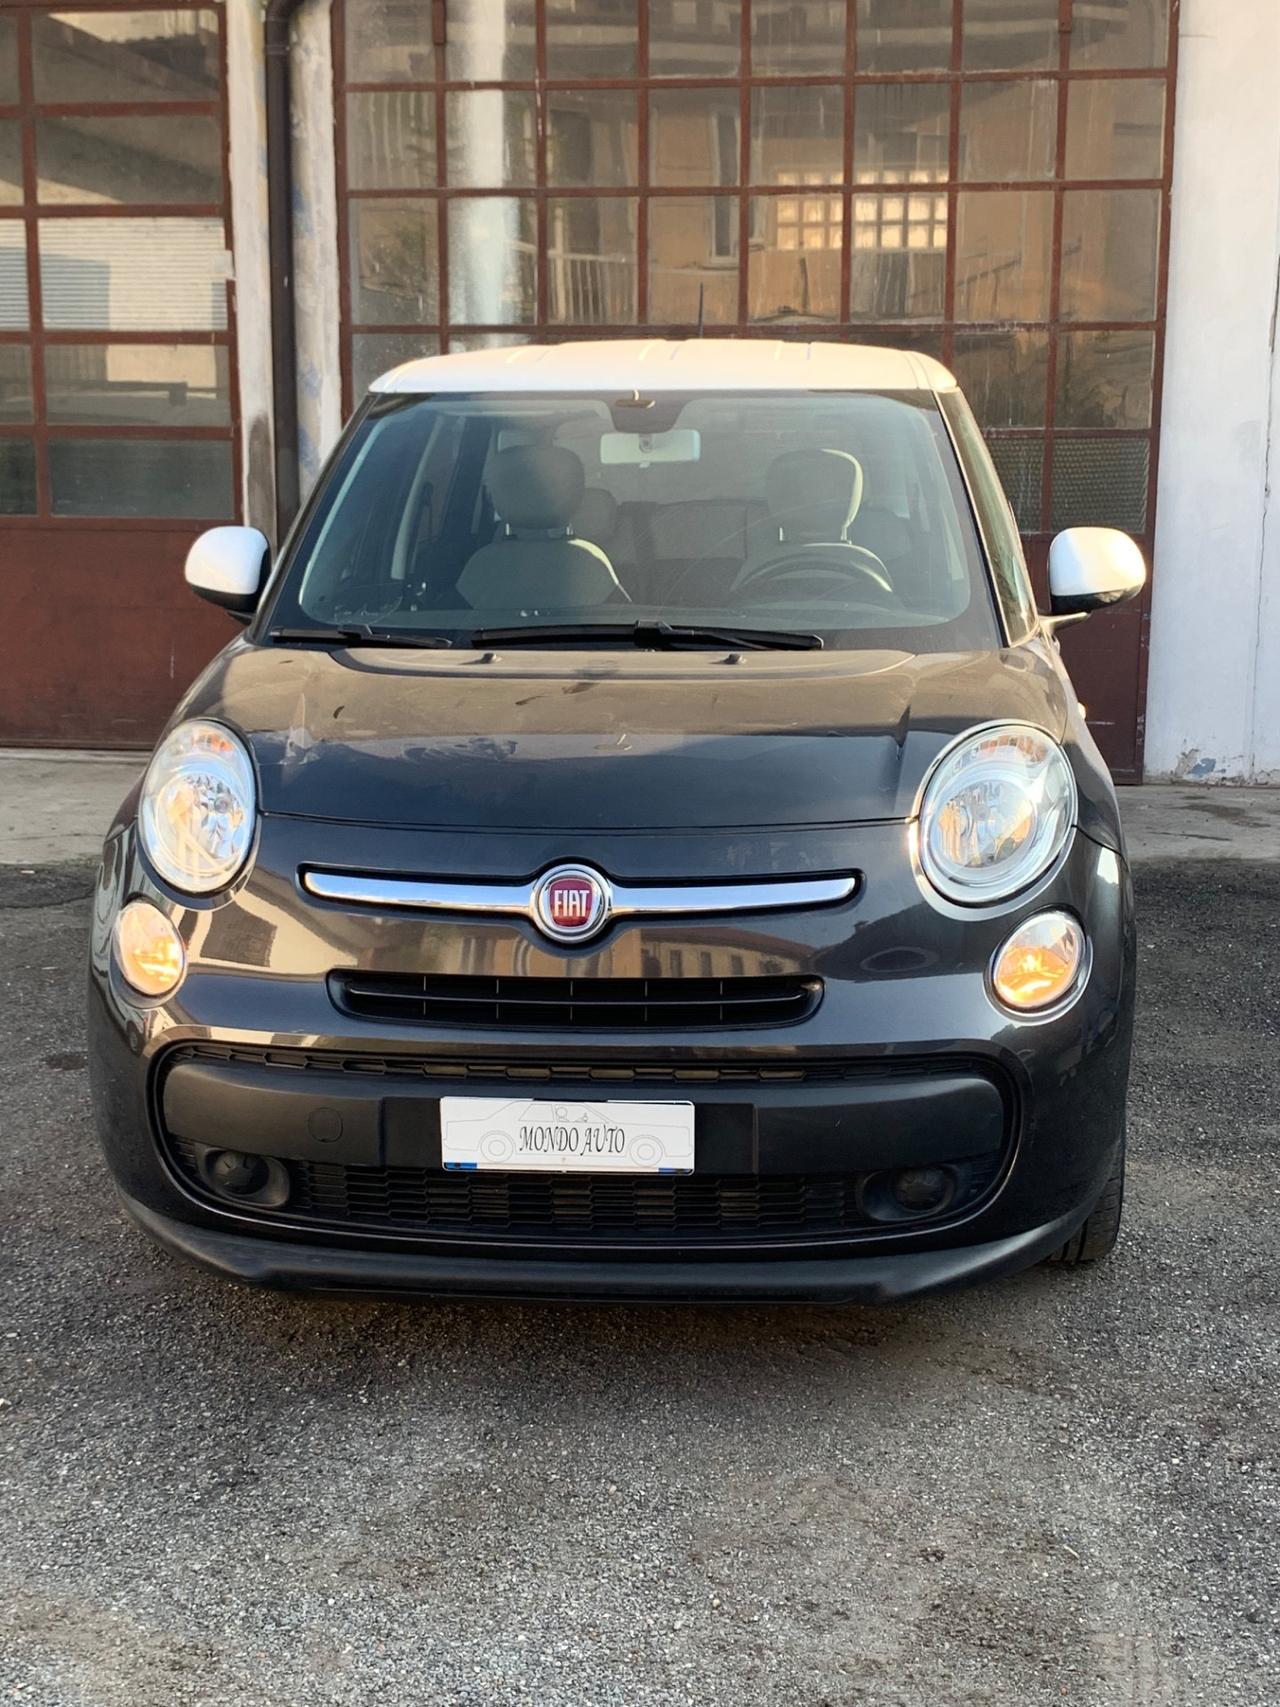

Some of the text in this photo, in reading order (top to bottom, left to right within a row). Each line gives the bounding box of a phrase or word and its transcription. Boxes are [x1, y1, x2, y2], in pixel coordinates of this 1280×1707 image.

[554, 889, 590, 917] FIAT
[519, 1125, 625, 1156] MONDO AUTO
